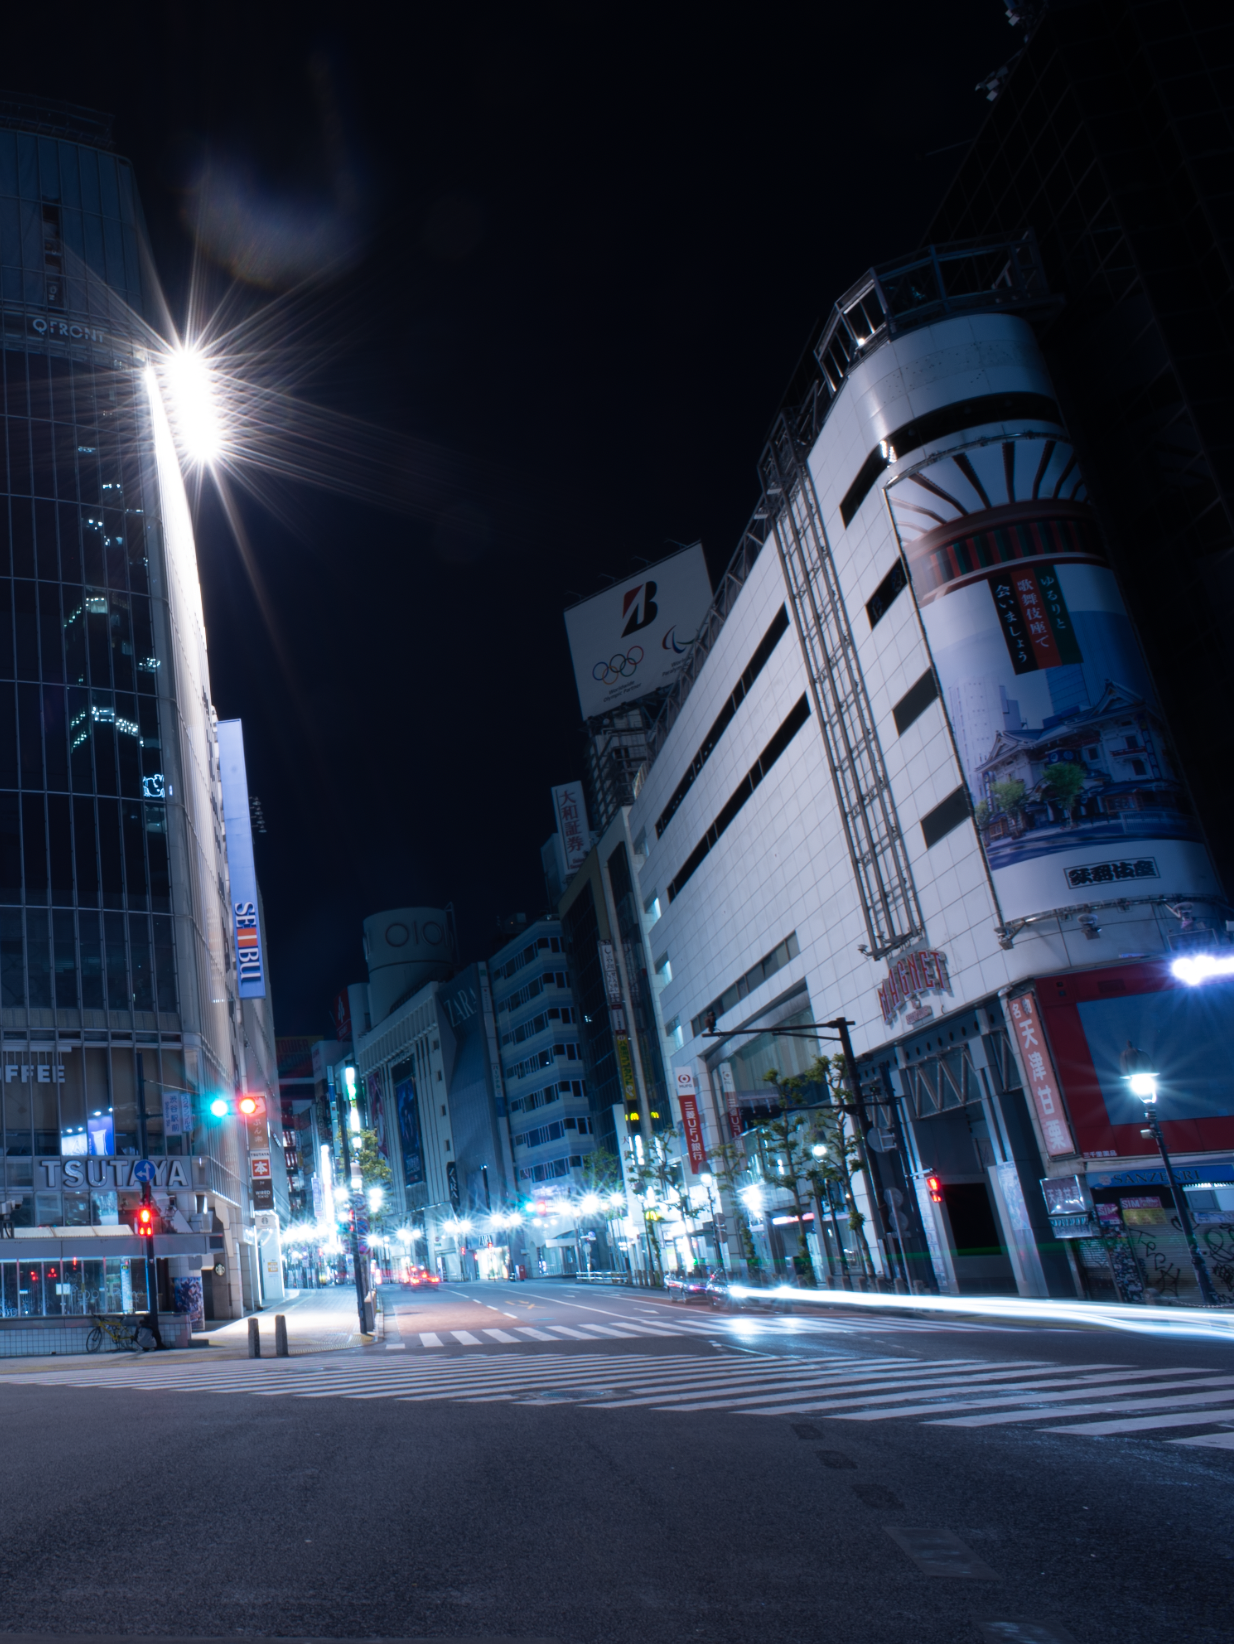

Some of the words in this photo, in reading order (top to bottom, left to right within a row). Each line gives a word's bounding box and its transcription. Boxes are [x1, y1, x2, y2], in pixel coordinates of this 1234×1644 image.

[32, 318, 104, 343] QFRONT
[995, 584, 1027, 663] 会いましょう
[1040, 575, 1066, 629] ゆるりと
[559, 790, 584, 853] 大和証券
[235, 902, 262, 981] SEIBU
[877, 951, 947, 1024] MAGNET
[1019, 1019, 1066, 1149] 天津甘栗
[254, 1161, 268, 1175] 本
[1121, 1199, 1140, 1209] SIM
